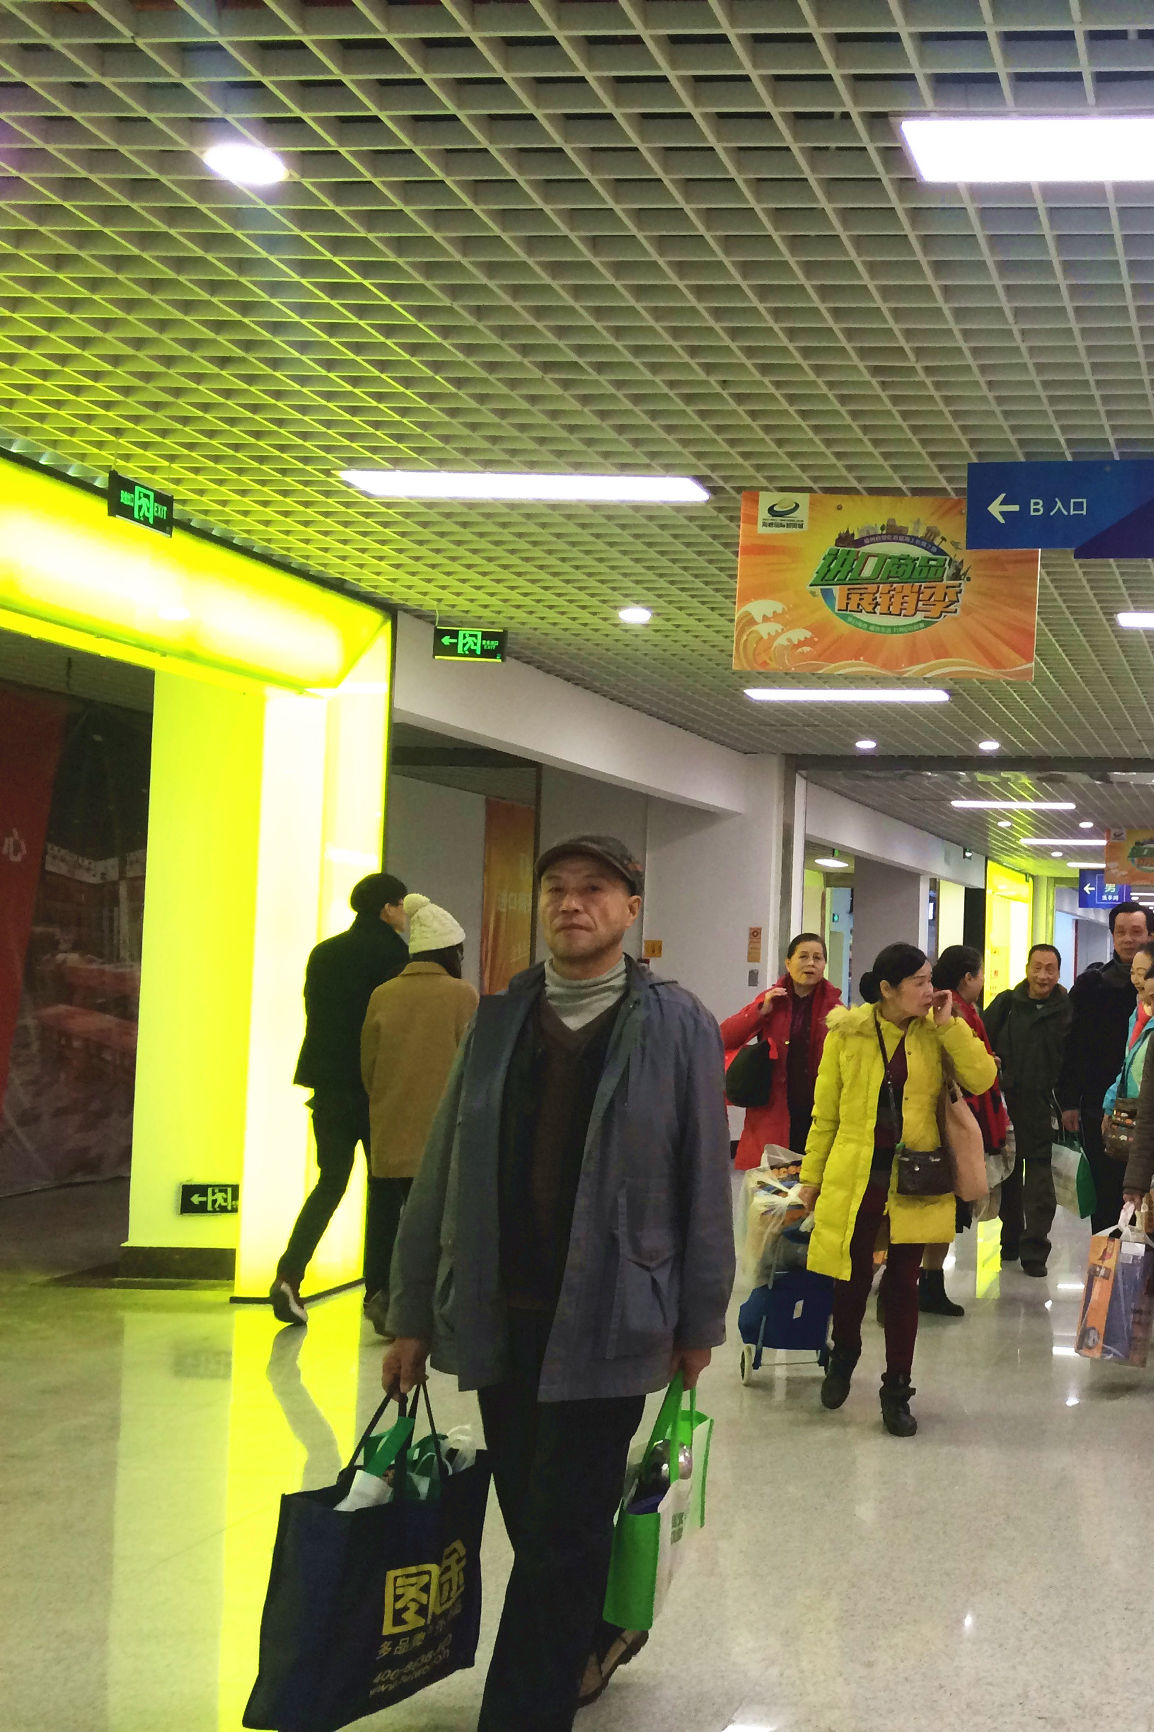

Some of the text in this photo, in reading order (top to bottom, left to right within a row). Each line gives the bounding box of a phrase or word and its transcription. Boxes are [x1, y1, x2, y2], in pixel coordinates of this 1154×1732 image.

[1030, 497, 1087, 516] B 入口
[808, 548, 947, 587] 进口商品
[837, 583, 963, 619] 展销季
